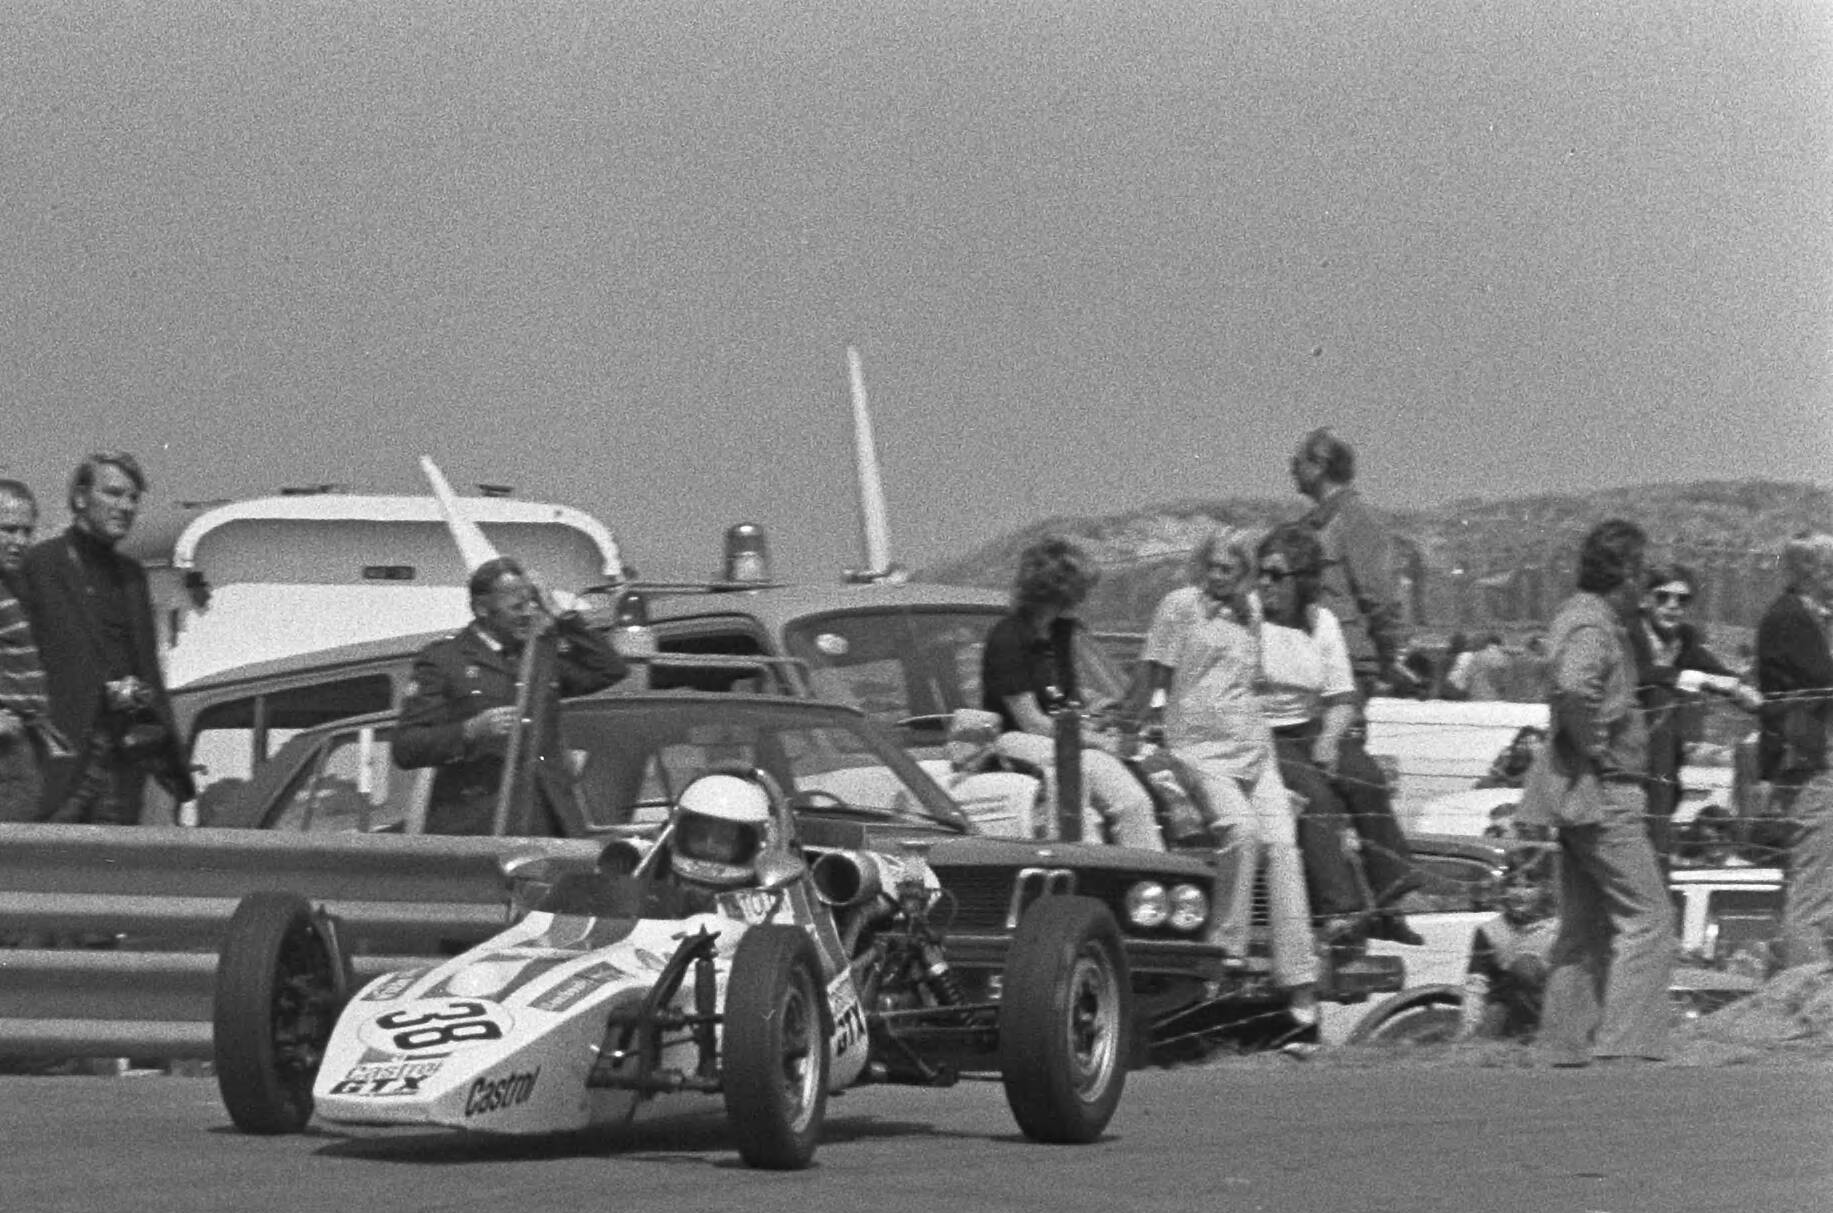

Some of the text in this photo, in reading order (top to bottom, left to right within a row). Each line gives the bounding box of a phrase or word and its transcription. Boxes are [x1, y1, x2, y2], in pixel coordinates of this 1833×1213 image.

[376, 1002, 503, 1050] 38
[329, 1074, 428, 1095] GTX
[465, 1064, 541, 1117] Castrol
